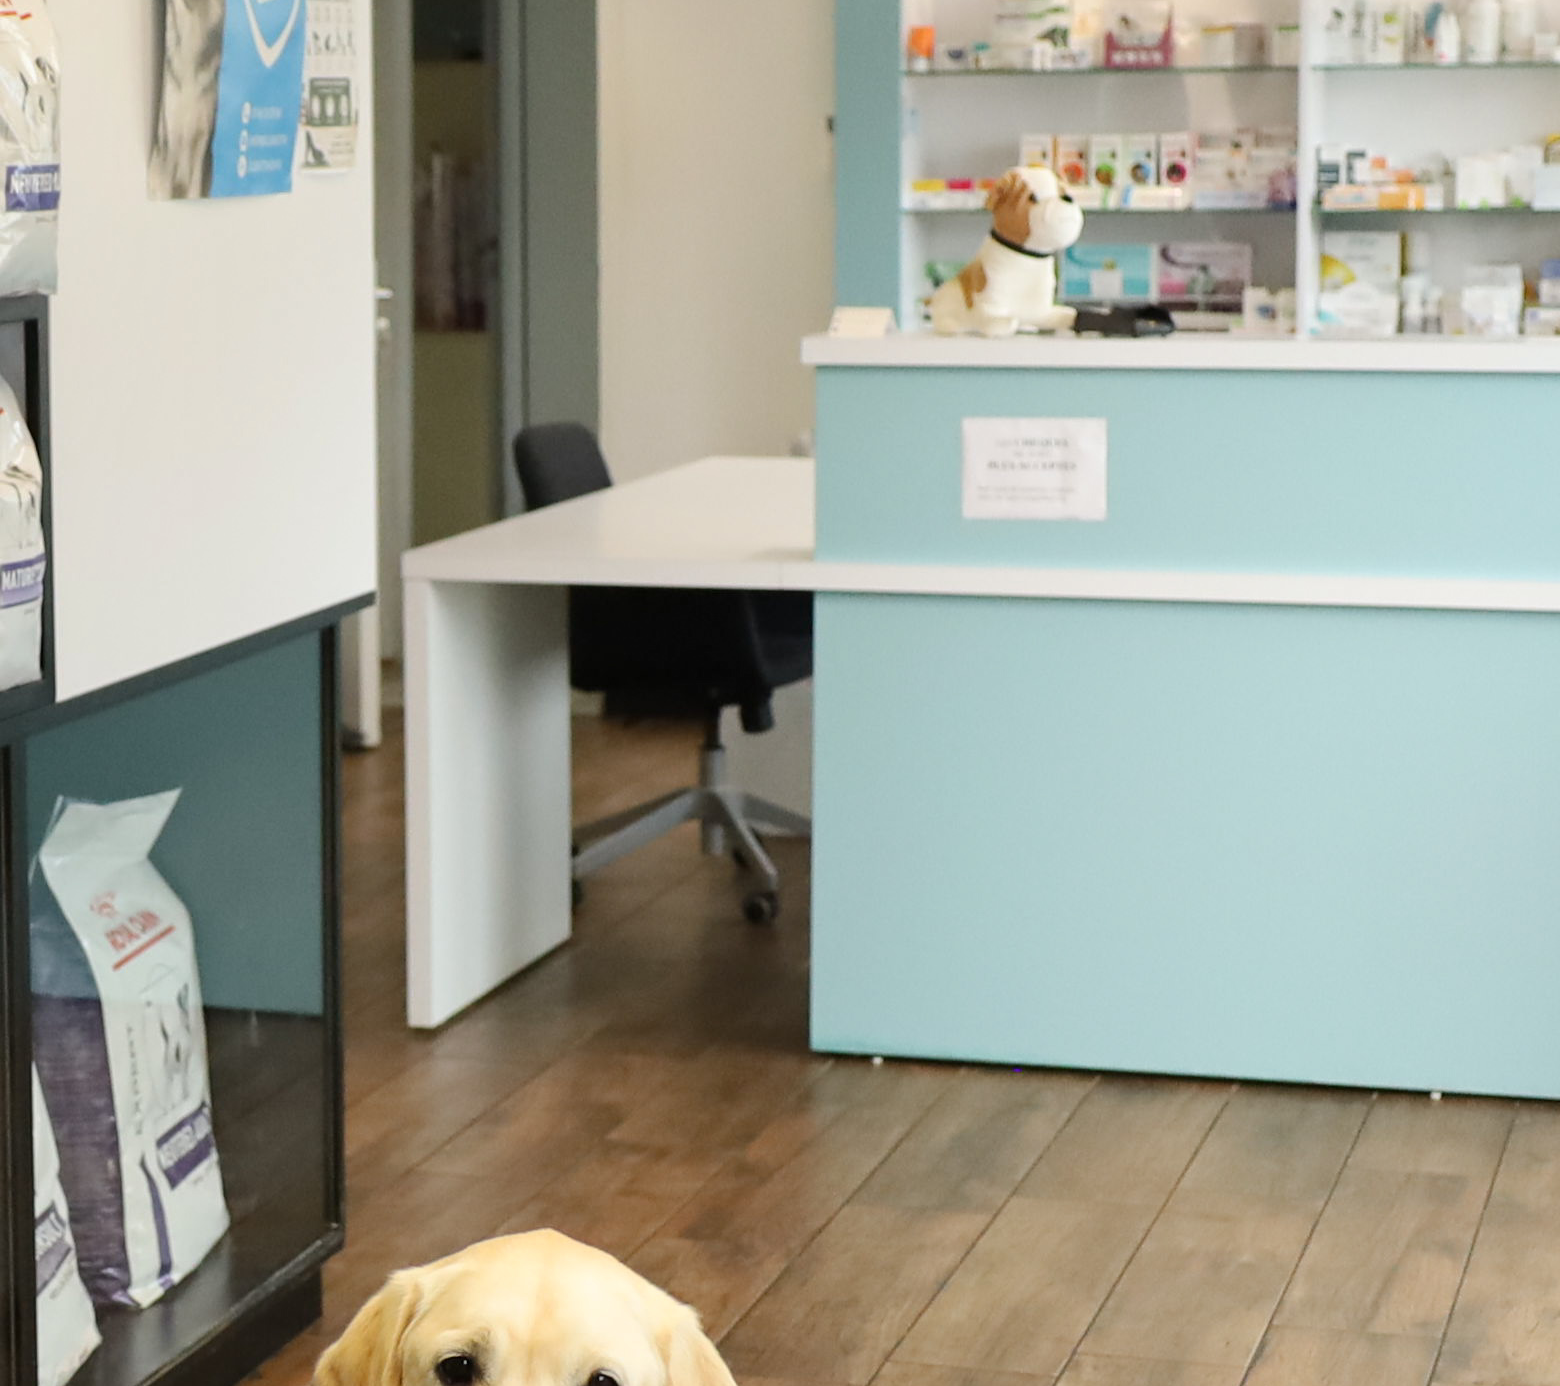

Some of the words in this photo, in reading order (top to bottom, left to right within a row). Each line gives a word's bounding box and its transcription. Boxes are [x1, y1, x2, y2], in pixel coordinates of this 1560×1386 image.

[1, 568, 32, 591] MATURE
[105, 923, 136, 953] ROYAL
[132, 909, 161, 939] CANIN
